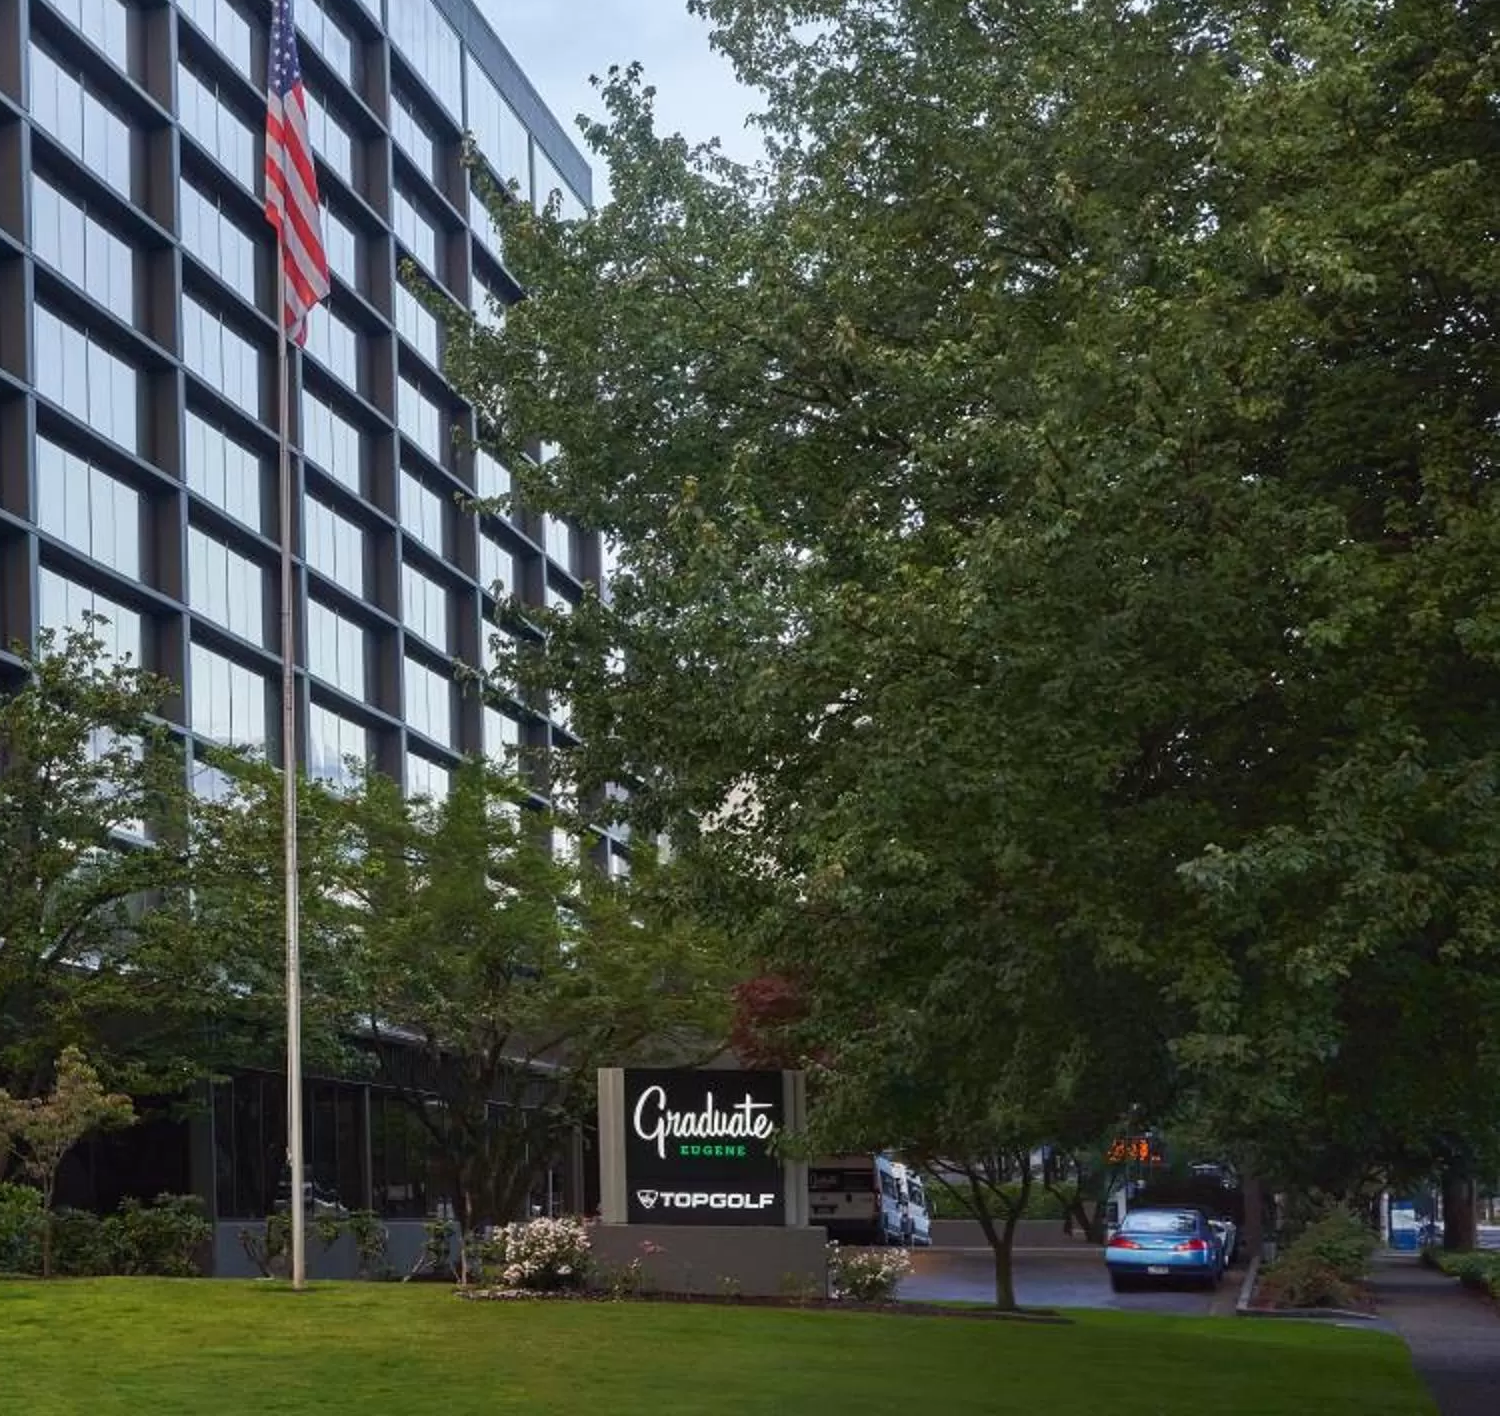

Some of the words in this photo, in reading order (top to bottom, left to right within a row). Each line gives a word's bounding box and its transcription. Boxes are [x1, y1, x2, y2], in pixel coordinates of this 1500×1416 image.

[633, 1085, 773, 1159] Graduate
[679, 1145, 747, 1157] EUGENE
[660, 1192, 775, 1209] TOPGOLF
